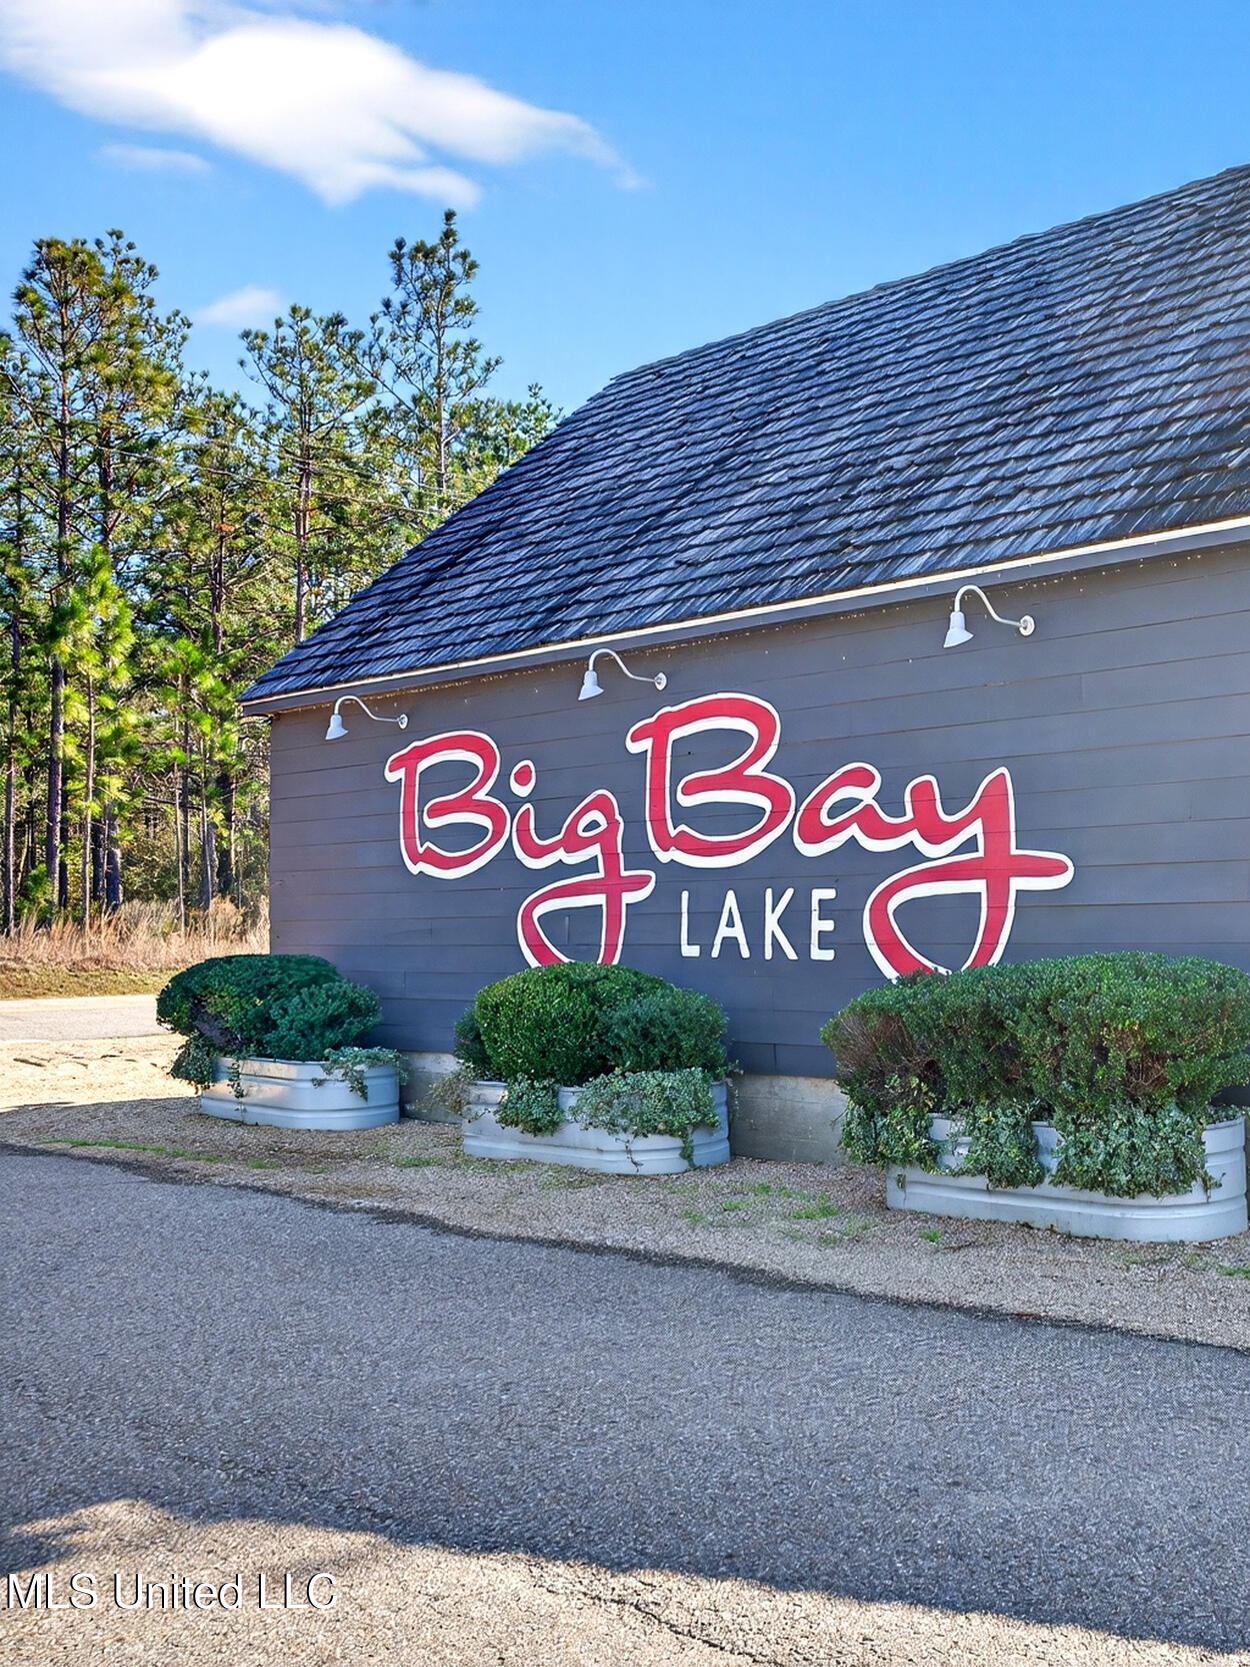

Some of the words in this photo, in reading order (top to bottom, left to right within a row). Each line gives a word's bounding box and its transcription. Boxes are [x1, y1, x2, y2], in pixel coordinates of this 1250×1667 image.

[385, 731, 655, 965] Big
[626, 692, 1074, 982] Bay
[679, 888, 836, 961] LAKE
